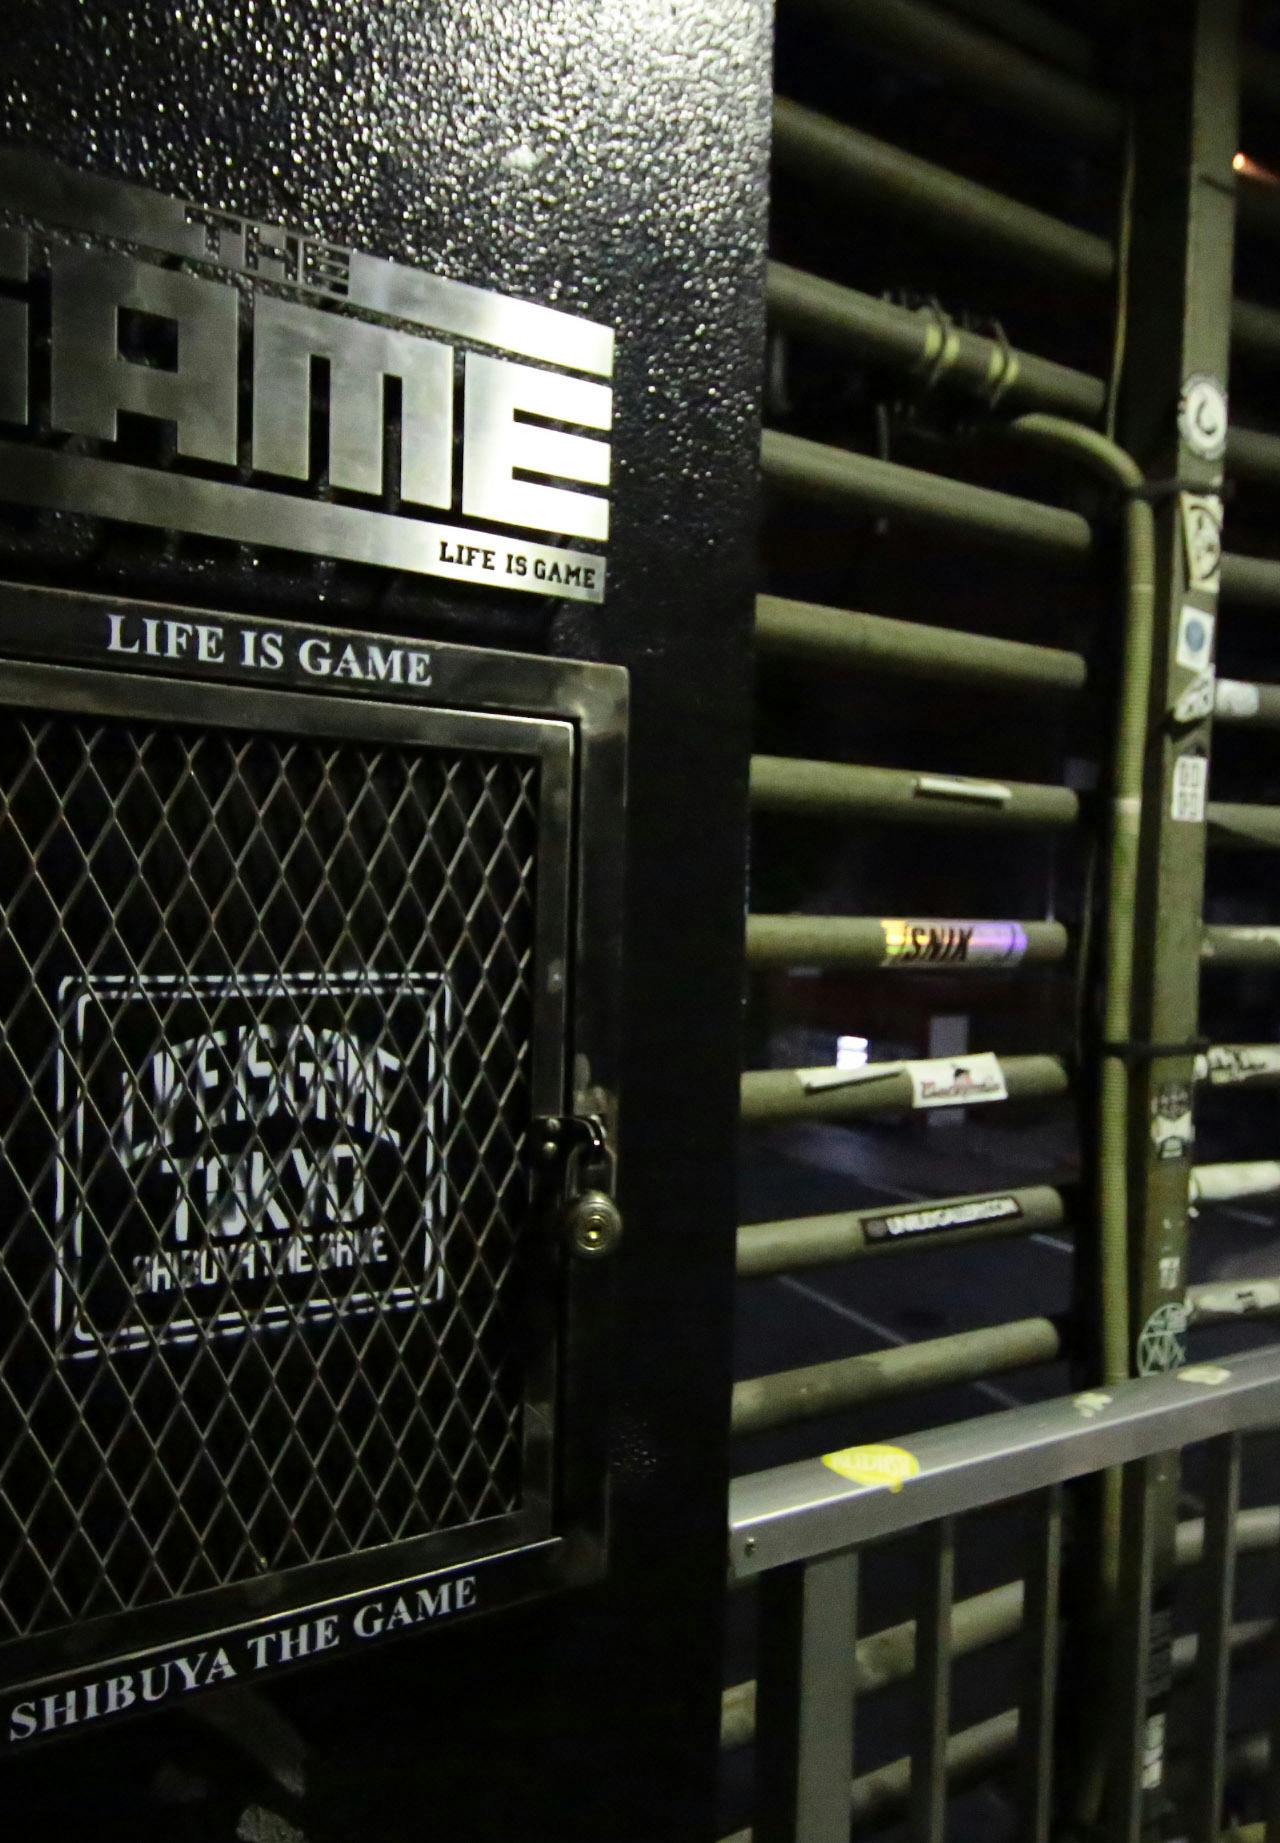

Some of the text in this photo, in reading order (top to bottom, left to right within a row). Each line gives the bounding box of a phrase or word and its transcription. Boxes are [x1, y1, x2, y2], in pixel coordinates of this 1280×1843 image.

[184, 203, 352, 296] THE
[439, 541, 596, 589] LIFE IS GAME
[106, 614, 433, 687] LIFE IS GAME
[160, 1144, 365, 1242] TOKYO
[8, 1574, 480, 1743] SHIBUYA THE GAME
